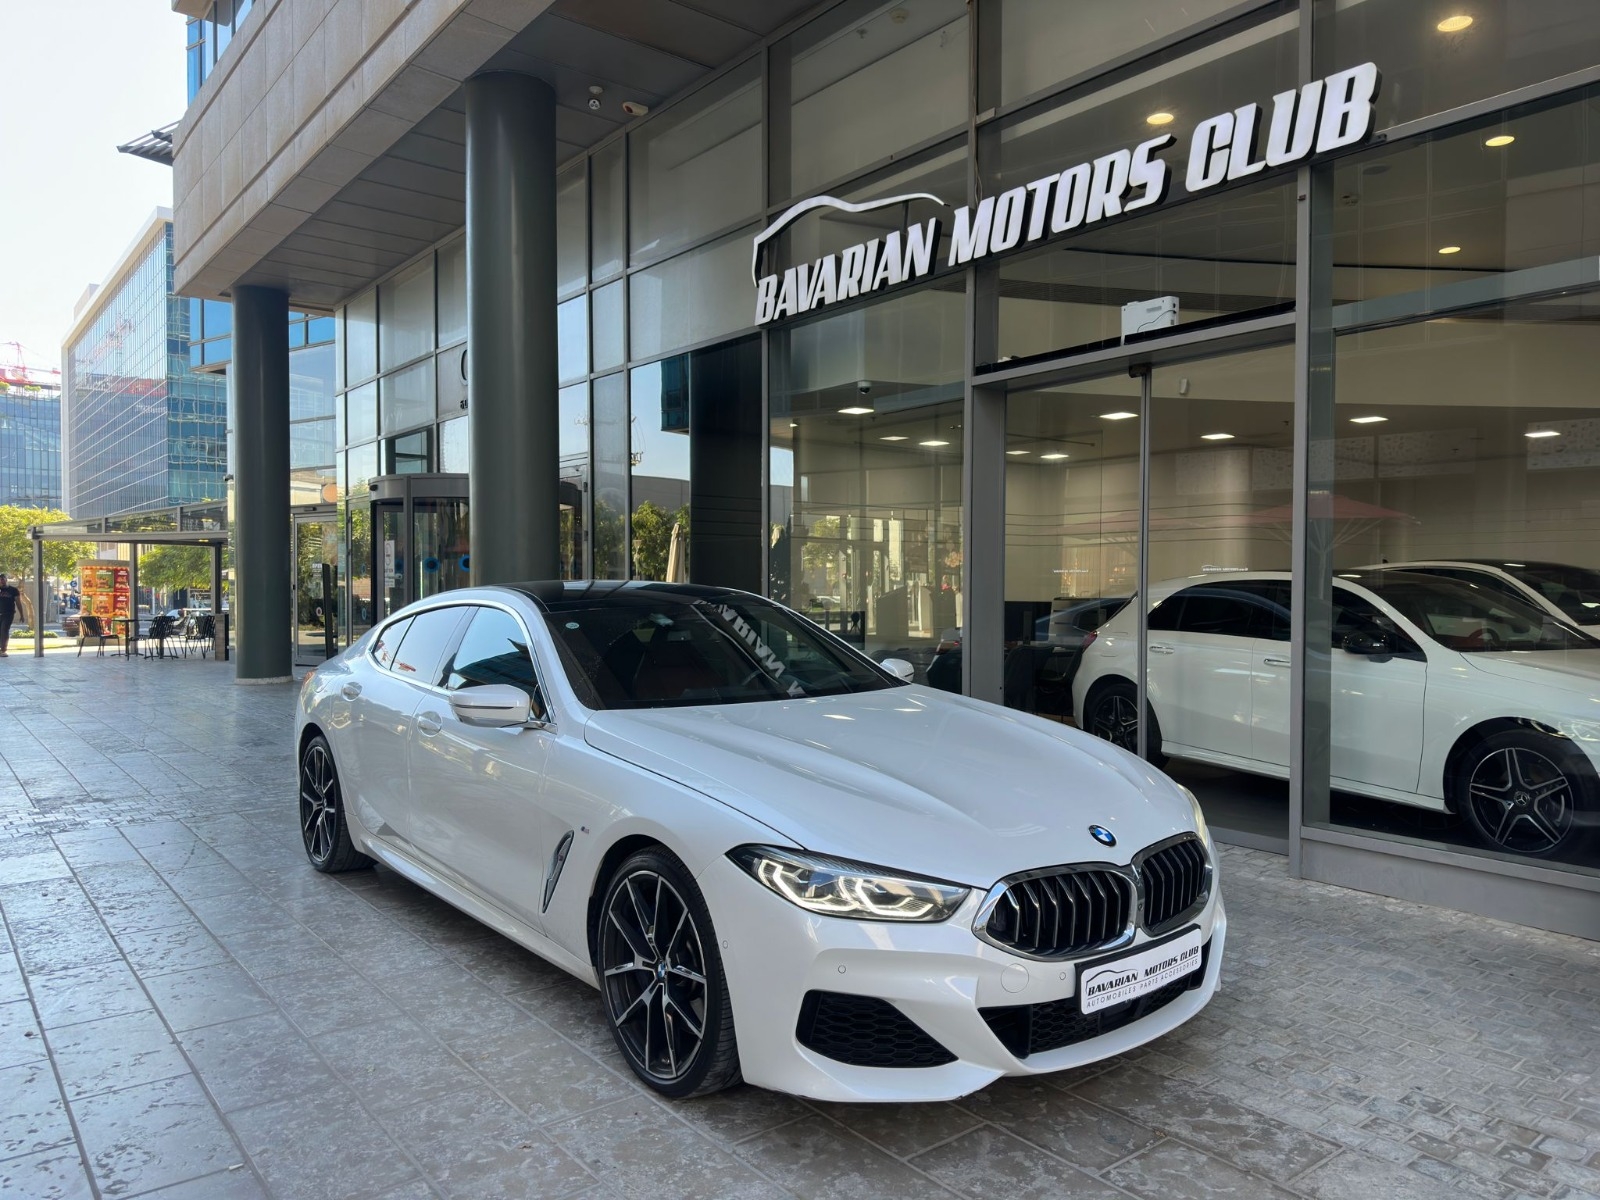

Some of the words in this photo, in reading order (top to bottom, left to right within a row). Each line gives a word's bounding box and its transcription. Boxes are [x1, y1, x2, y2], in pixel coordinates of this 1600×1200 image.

[755, 217, 937, 326] BAVARIAN
[948, 133, 1173, 267] MOTORS
[1185, 62, 1378, 192] CLUB
[1087, 986, 1136, 1008] AUTOMOBILES
[1140, 979, 1158, 990] PARTS
[1161, 959, 1198, 980] ACCESSORIES
[1088, 972, 1139, 997] BAVARIAN
[1144, 957, 1178, 977] MOTORS
[1180, 946, 1199, 961] CLUB
